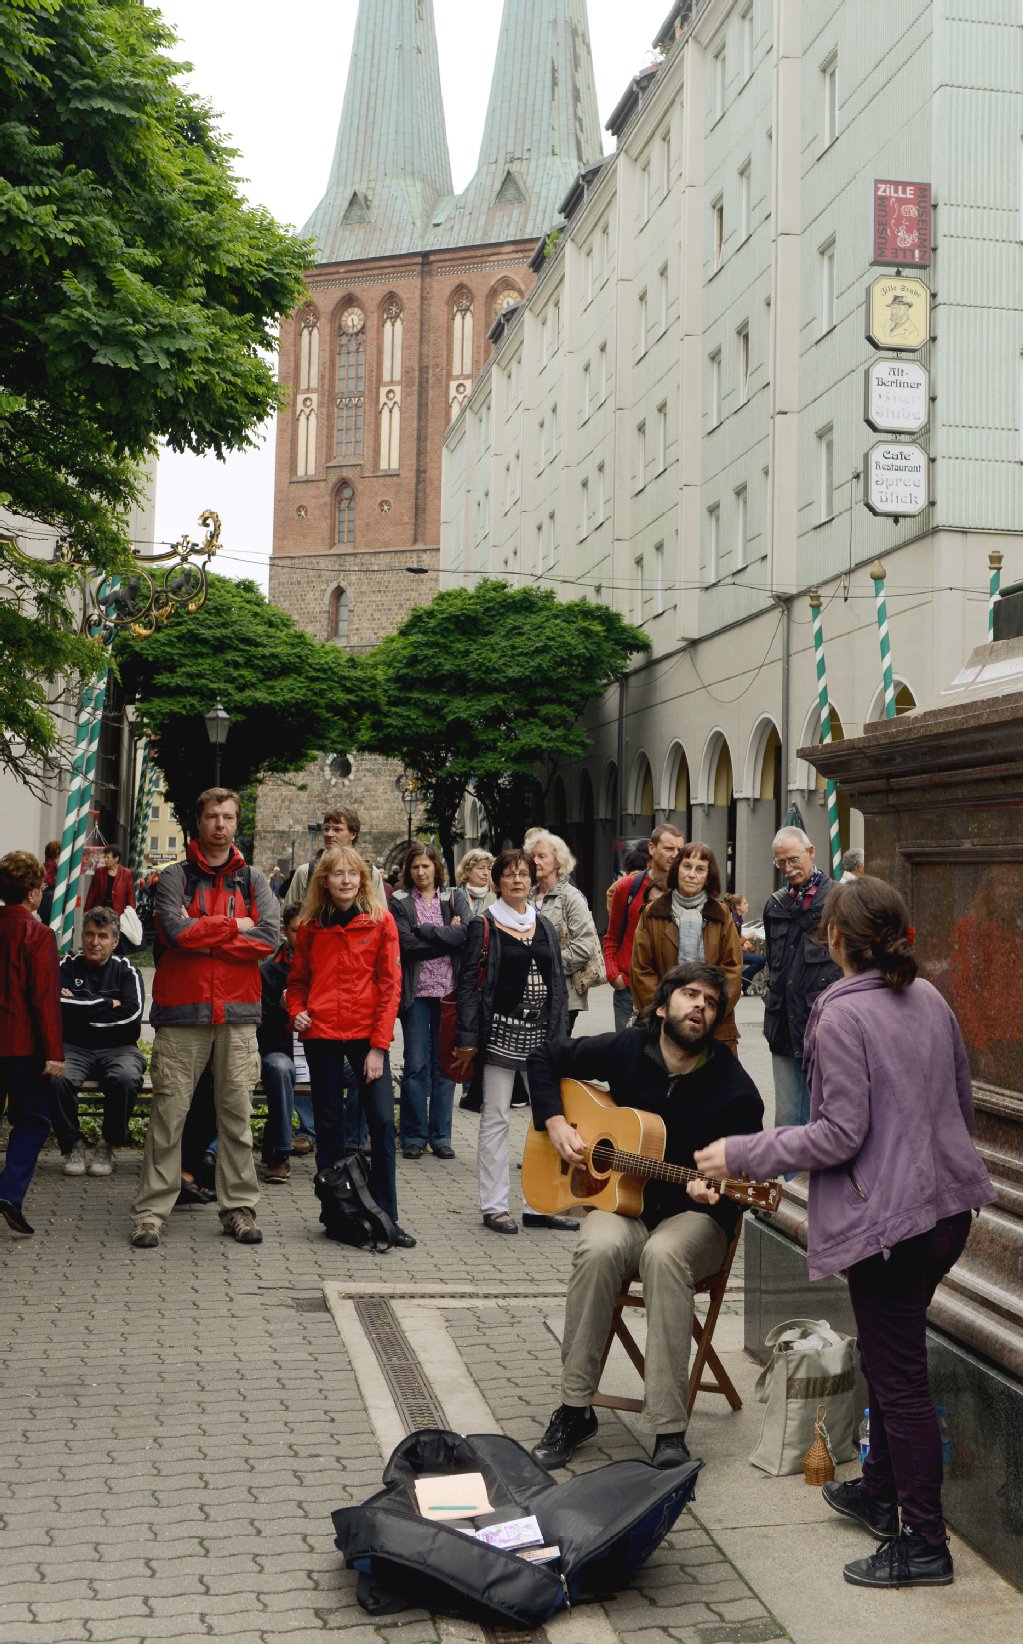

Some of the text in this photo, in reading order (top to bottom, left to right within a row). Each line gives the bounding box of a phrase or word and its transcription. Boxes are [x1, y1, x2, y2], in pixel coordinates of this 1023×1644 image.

[878, 196, 888, 258] MUSEUM
[917, 187, 928, 249] MUSEUM
[875, 377, 922, 389] Berliner
[875, 461, 921, 473] Restaurant
